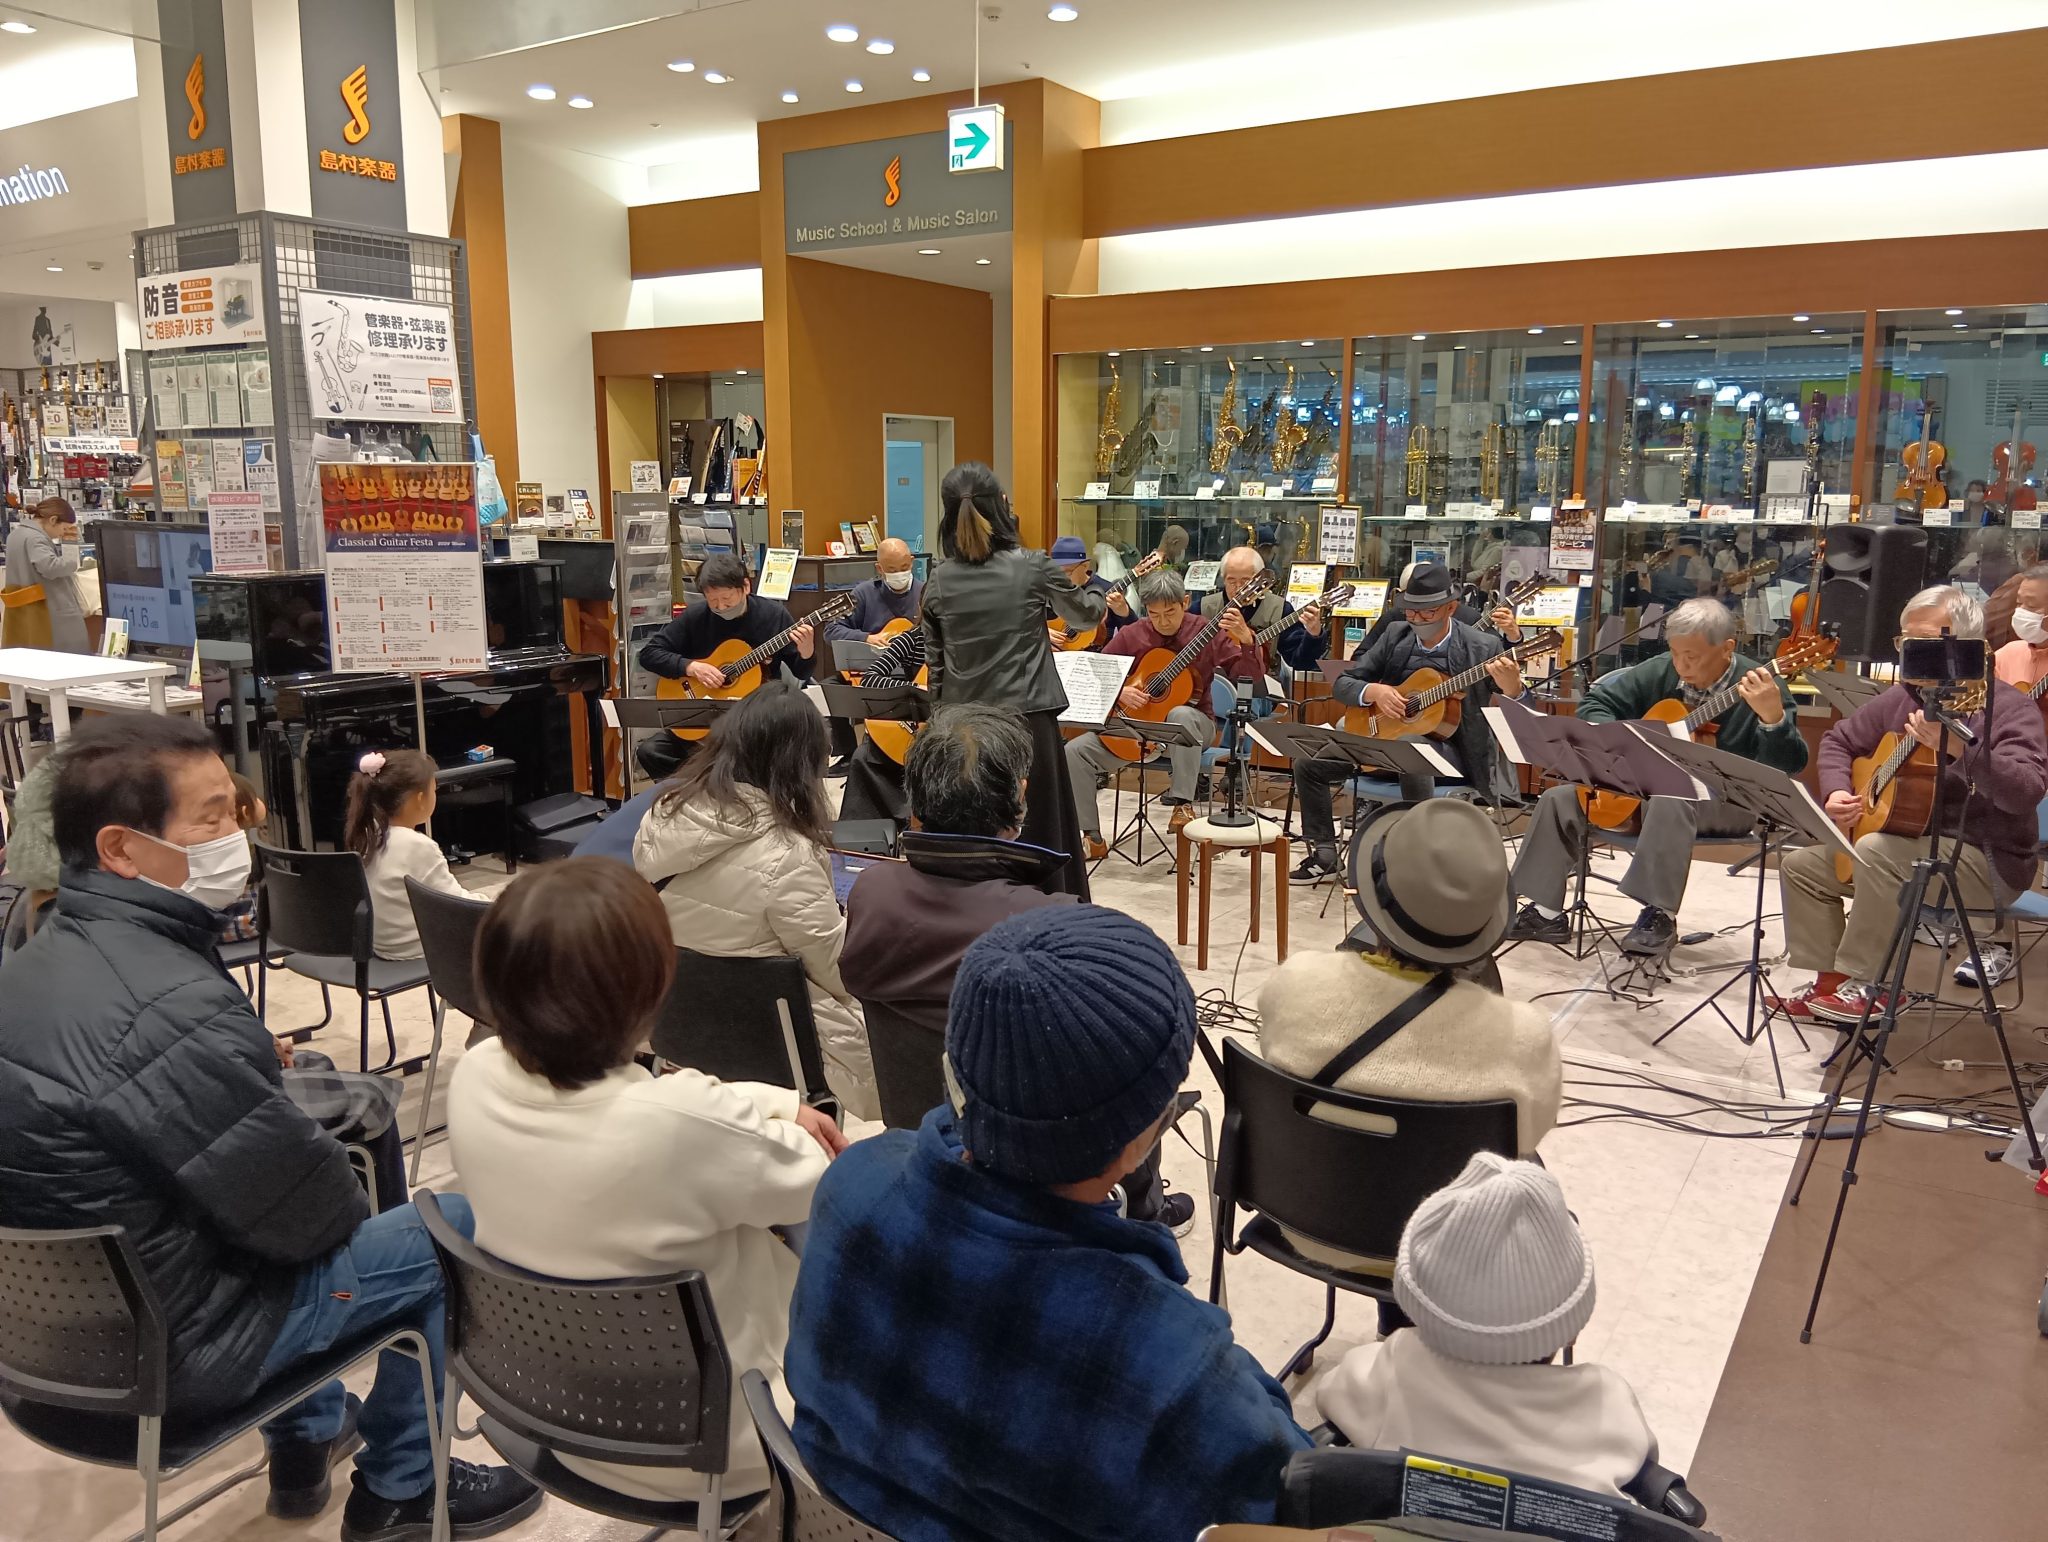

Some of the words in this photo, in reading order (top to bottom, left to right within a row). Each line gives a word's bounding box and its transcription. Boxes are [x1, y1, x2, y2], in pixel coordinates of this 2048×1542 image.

[175, 148, 225, 175] 島村楽器
[319, 149, 396, 181] 島村楽器
[796, 225, 835, 243] Music
[839, 219, 888, 239] School
[892, 217, 902, 233] &
[907, 212, 950, 232] Music
[954, 208, 998, 226] Salon
[143, 283, 178, 318] 防音
[145, 317, 215, 340] ご相談承ります
[365, 312, 447, 335] 管楽器・弦楽器
[367, 330, 448, 352] 修理承ります
[337, 537, 377, 547] Classical
[379, 537, 408, 547] Guitar
[410, 537, 434, 547] Festa
